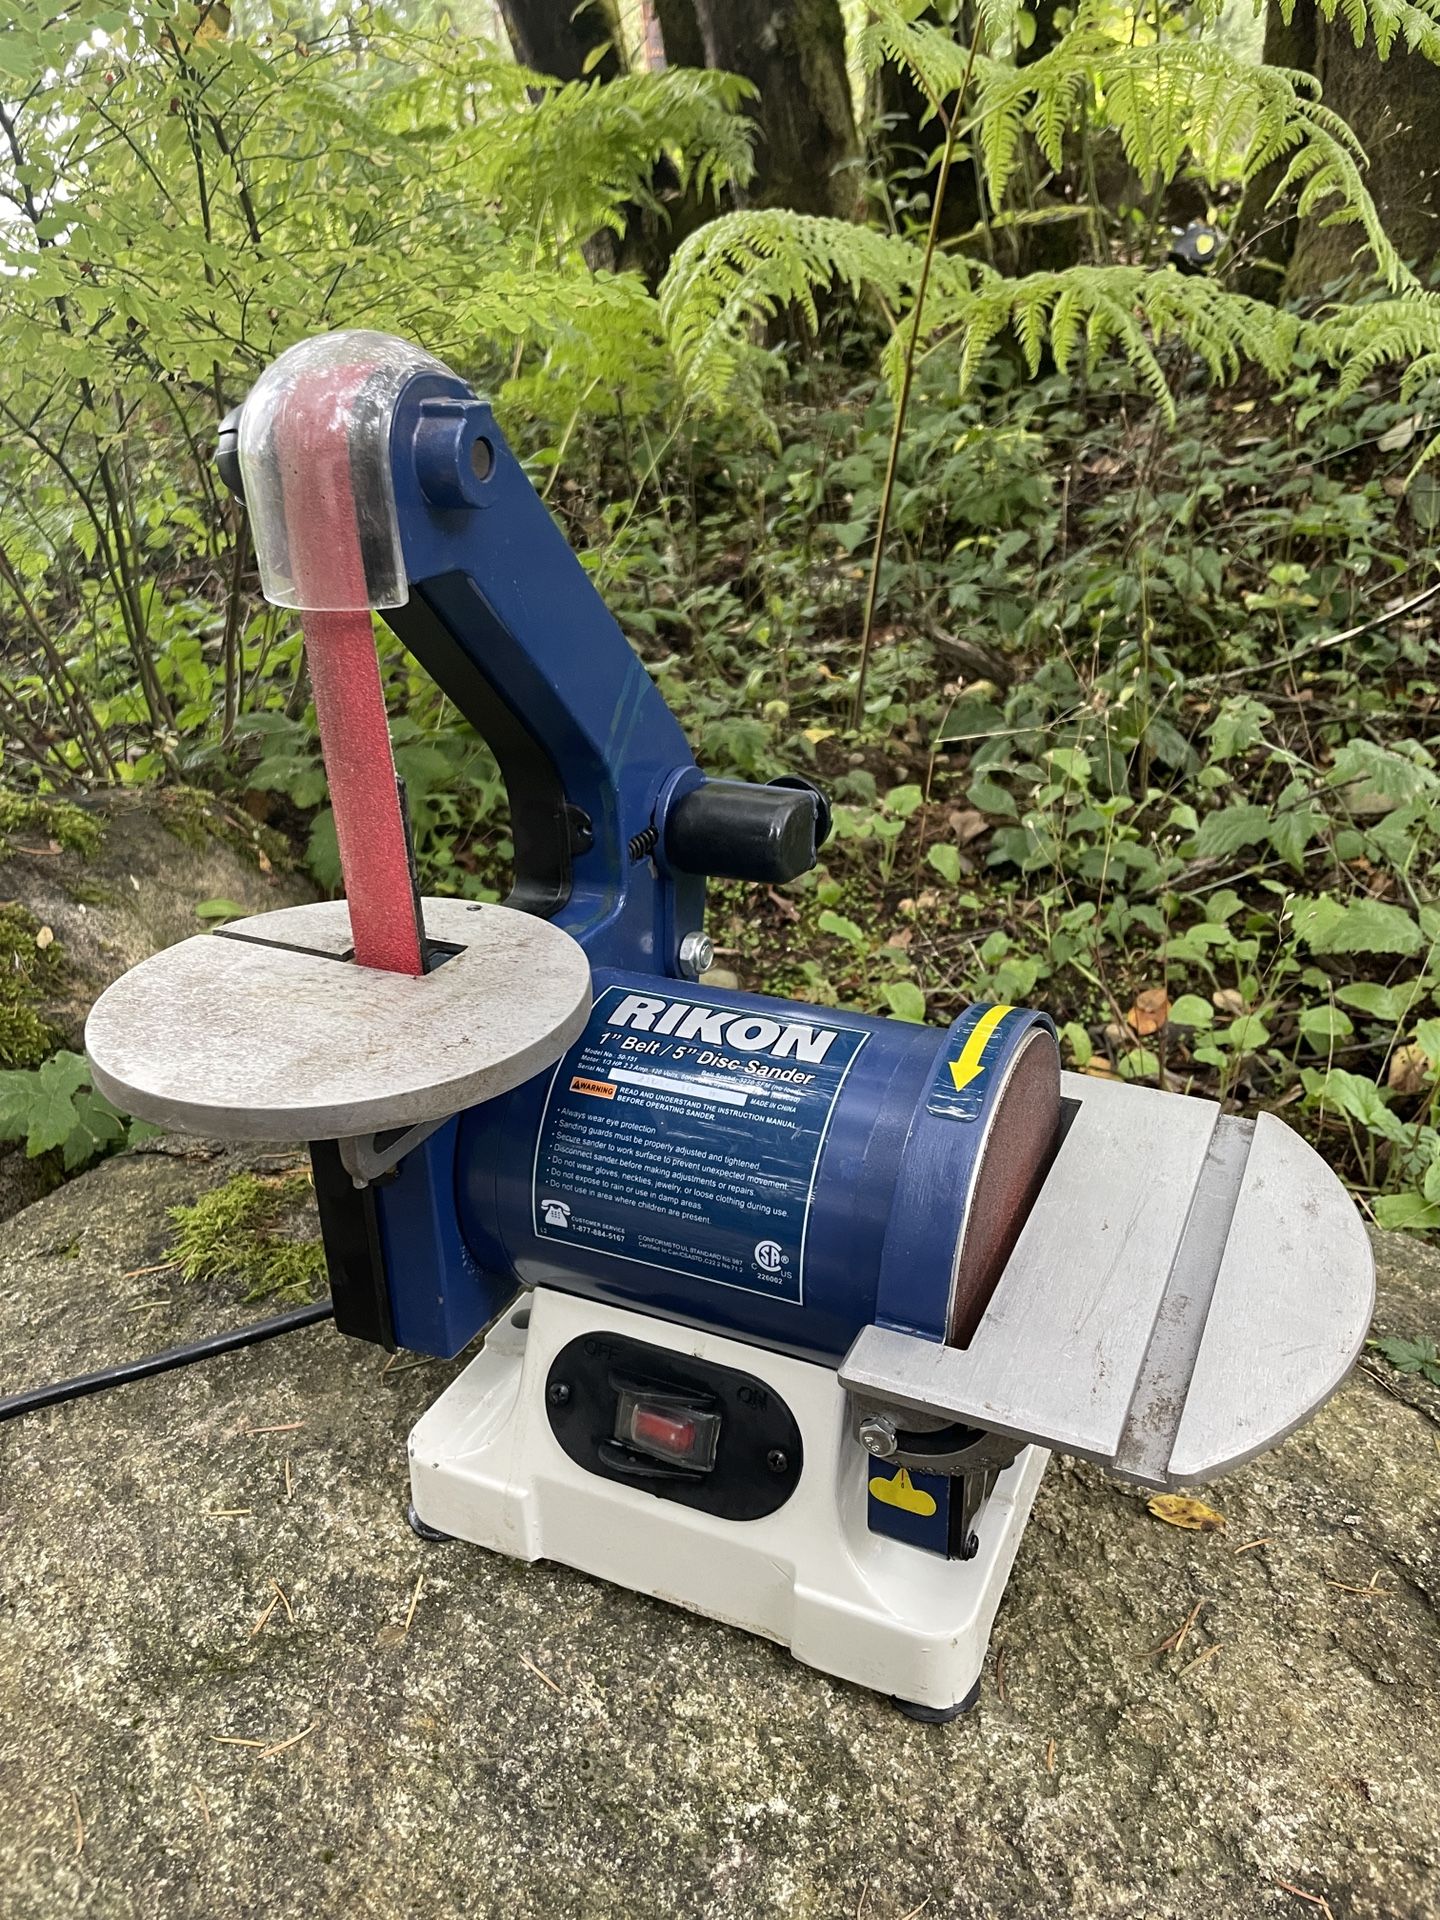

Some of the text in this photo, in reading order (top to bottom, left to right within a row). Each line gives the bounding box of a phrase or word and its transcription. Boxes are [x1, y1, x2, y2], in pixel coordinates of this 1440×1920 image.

[607, 994, 838, 1064] RIKON
[584, 1047, 603, 1056] Model
[620, 1036, 661, 1055] Belt
[659, 1043, 673, 1056] /
[696, 1050, 741, 1070] Disc
[744, 1059, 816, 1085] Sander
[577, 1062, 594, 1071] Serial
[580, 1054, 600, 1064] Motor:
[651, 1066, 662, 1075] 120
[580, 1080, 614, 1096] WARNING
[617, 1094, 645, 1106] BEFORE
[645, 1100, 685, 1115] OPERATING
[620, 1086, 639, 1096] READ
[639, 1090, 655, 1099] AND
[655, 1092, 702, 1110] UNDERSTAND
[702, 1103, 717, 1113] THE
[717, 1107, 765, 1122] INSTRUCTION
[750, 1098, 797, 1113] MADE IN CHINA
[560, 1107, 656, 1134] Always wear eye protection
[558, 1119, 761, 1171] Sanding guards must be properly adjusted and tightened.
[553, 1143, 592, 1159] Disconnect
[593, 1152, 618, 1165] sander
[619, 1158, 643, 1171] before
[643, 1165, 671, 1179] making
[671, 1170, 717, 1188] adjustments
[717, 1182, 727, 1190] or
[556, 1131, 581, 1144] Secure
[582, 1137, 607, 1149] sander
[607, 1143, 615, 1152] to
[616, 1145, 634, 1156] work
[635, 1150, 662, 1162] surface
[663, 1155, 671, 1164] to
[671, 1158, 701, 1171] prevent
[701, 1164, 745, 1181] unexpected
[550, 1167, 561, 1176] Do
[562, 1170, 574, 1179] not
[575, 1175, 600, 1187] expose
[601, 1180, 610, 1188] to
[610, 1182, 625, 1192] rain
[625, 1186, 634, 1194] or
[634, 1188, 649, 1197] use
[649, 1190, 657, 1198] in
[658, 1193, 679, 1205] damp
[552, 1155, 562, 1164] Do
[563, 1158, 576, 1167] not
[576, 1163, 594, 1172] wear
[594, 1166, 619, 1179] gloves,
[621, 1172, 654, 1187] neckties,
[683, 1186, 693, 1194] or
[693, 1188, 714, 1200] loose
[715, 1194, 745, 1209] clothing
[746, 1202, 771, 1215] during
[549, 1179, 711, 1225] Do not use in area where children are present.
[571, 1216, 626, 1234] CUSTOMER SERVICE
[571, 1224, 625, 1242] 1-877-884-5167
[638, 1241, 661, 1253] Certified
[689, 1247, 722, 1260] STANDARD
[757, 1272, 783, 1285] 226002
[780, 1270, 793, 1279] US
[583, 1339, 623, 1361] OFF
[737, 1385, 768, 1411] ON
